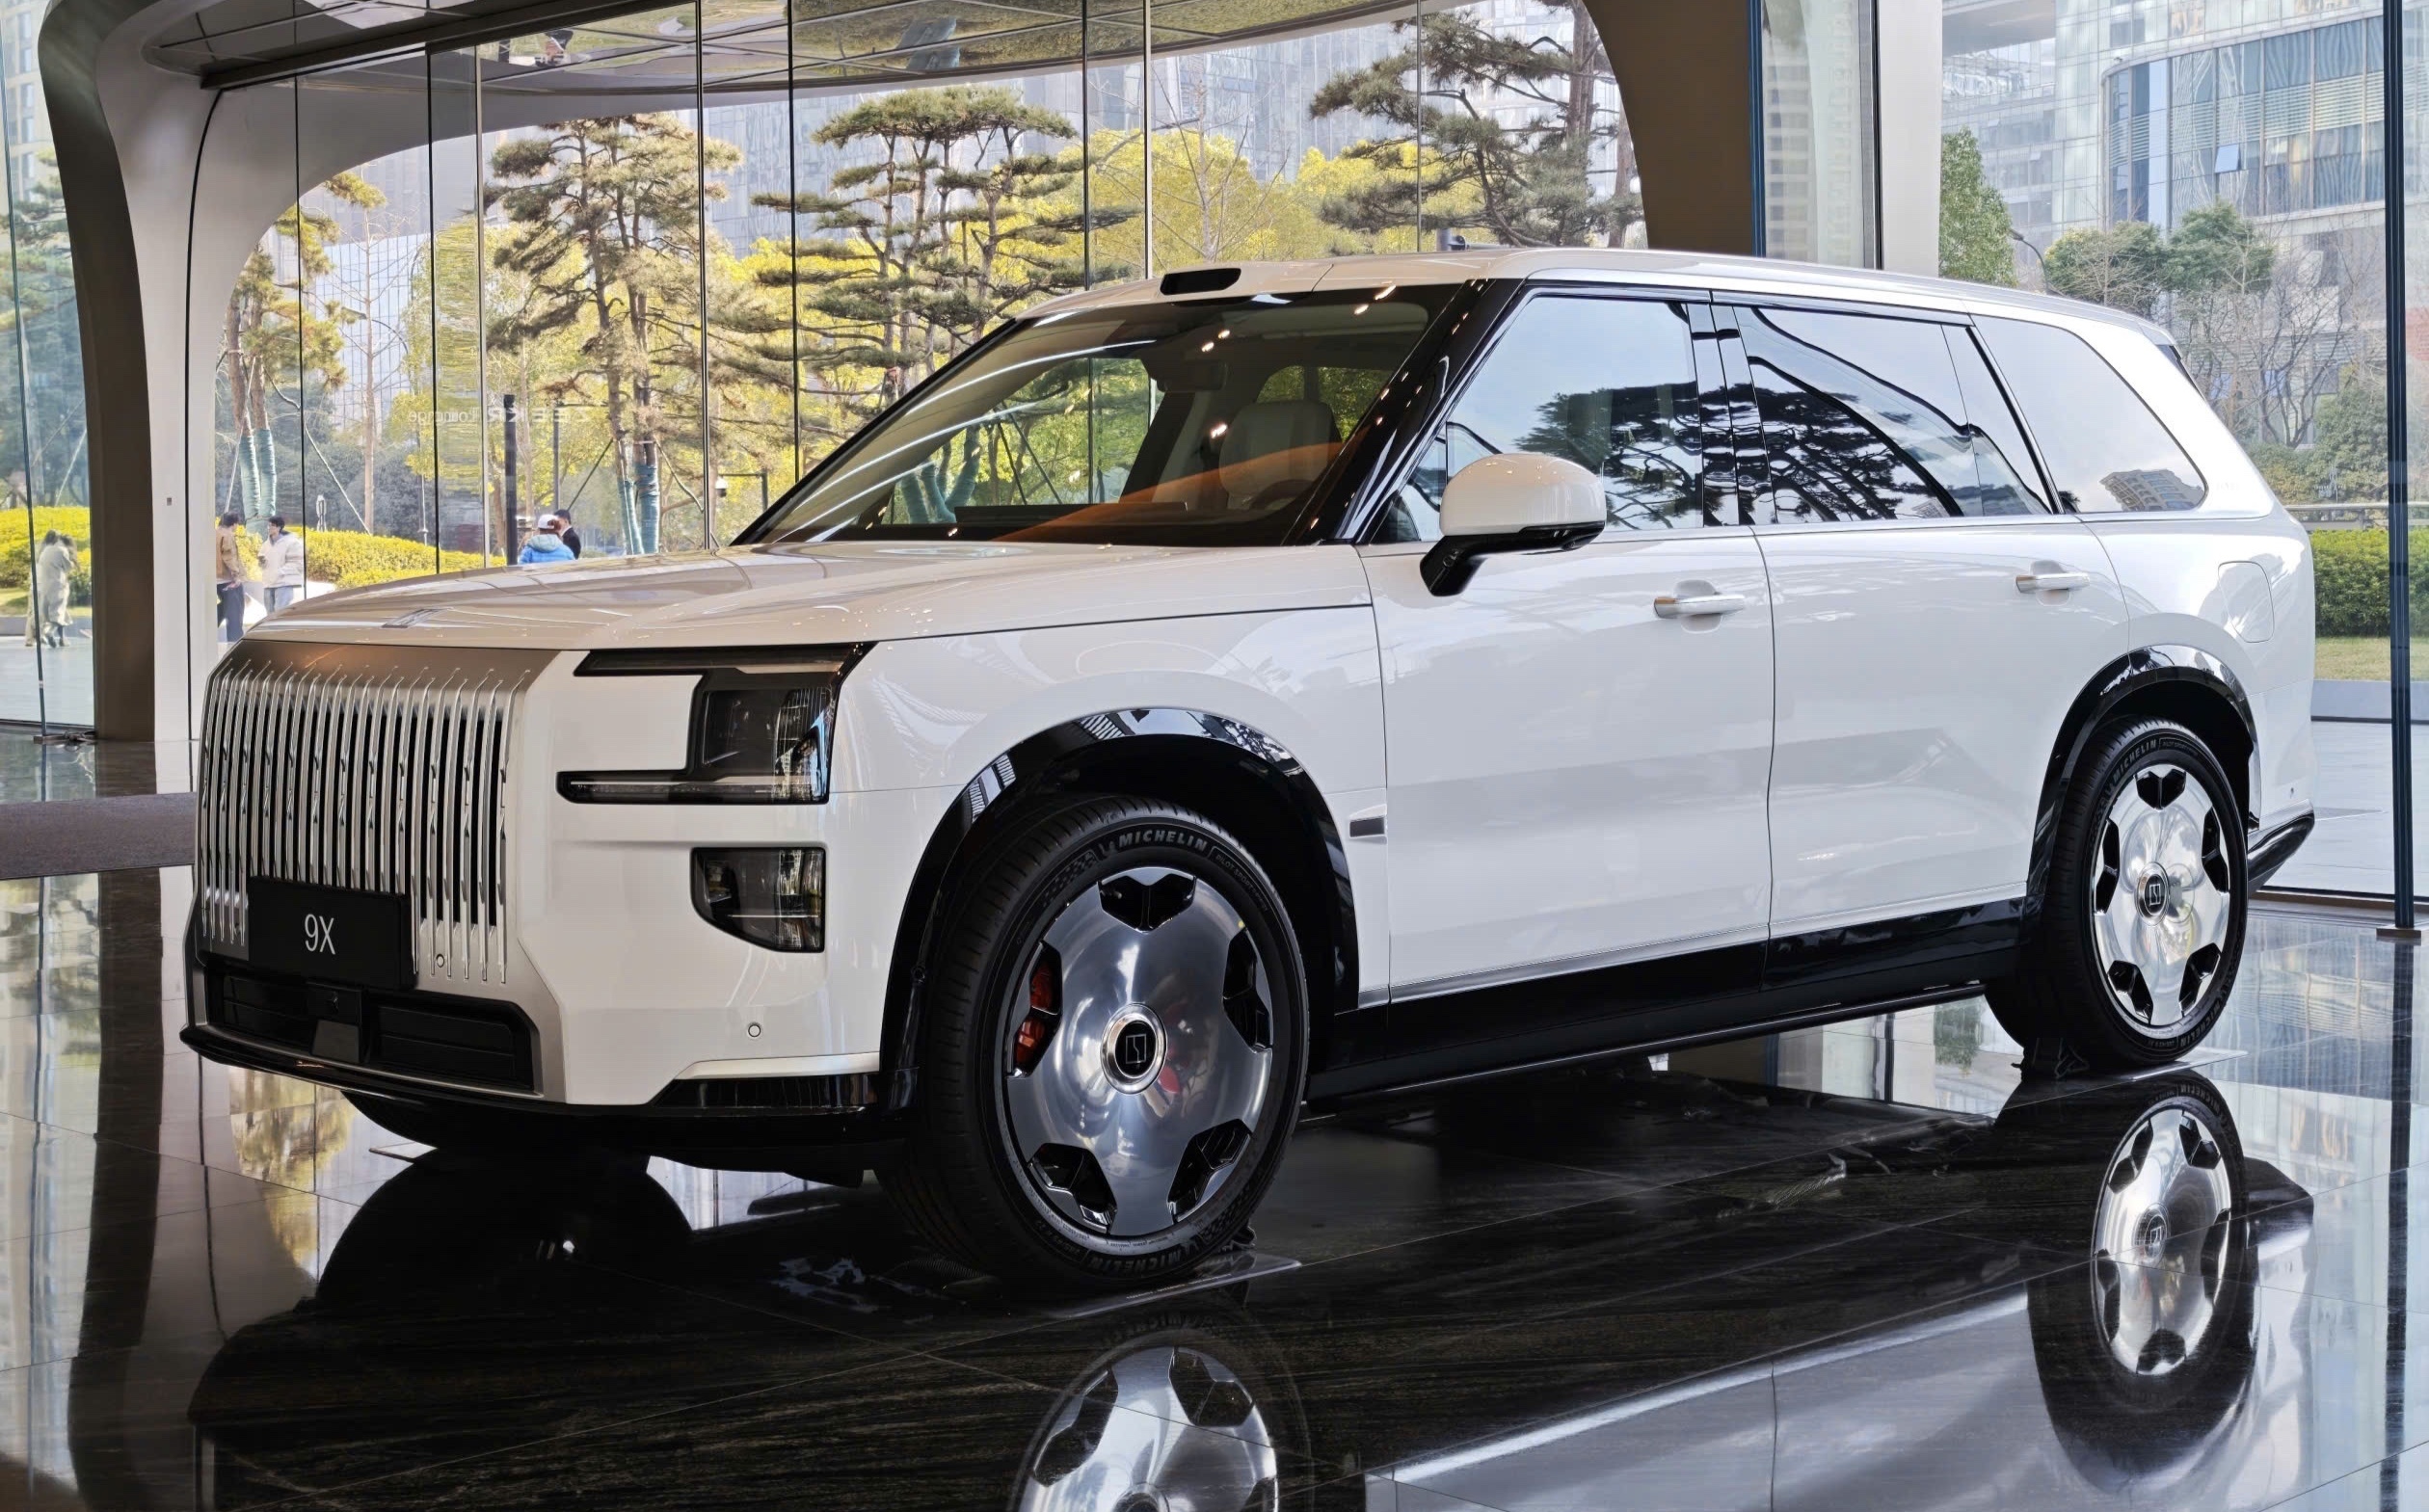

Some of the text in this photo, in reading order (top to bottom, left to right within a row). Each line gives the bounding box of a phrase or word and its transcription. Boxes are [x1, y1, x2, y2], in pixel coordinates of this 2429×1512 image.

[2113, 739, 2157, 783] MICHELIN
[1118, 829, 1208, 852] MICHELIN
[1215, 854, 1235, 870] PILOT
[305, 914, 335, 955] 9X
[2180, 1000, 2221, 1048] MICHELIN
[1088, 1250, 1181, 1275] MICHELIN
